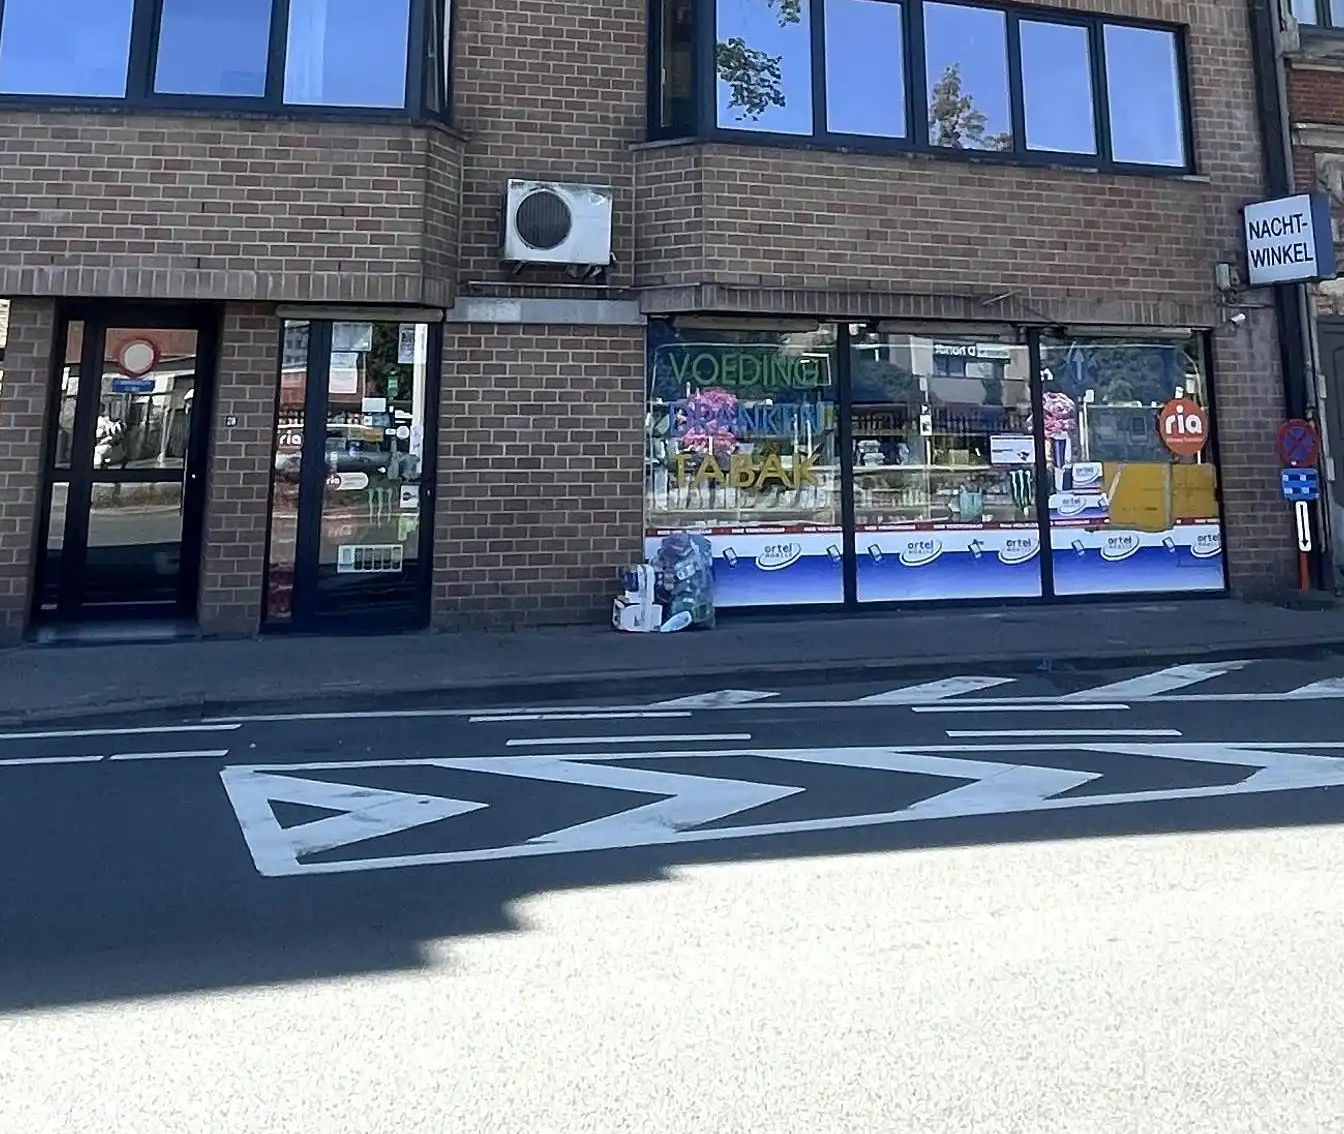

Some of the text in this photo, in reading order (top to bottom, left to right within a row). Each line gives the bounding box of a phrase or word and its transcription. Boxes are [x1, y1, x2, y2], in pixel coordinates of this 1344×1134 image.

[1248, 212, 1308, 240] NACHT-
[1249, 242, 1314, 268] WINKEL
[668, 352, 819, 387] VOEDING
[1165, 404, 1203, 435] ria
[279, 429, 302, 445] ria
[672, 453, 821, 489] TABAK
[764, 543, 793, 554] ortel
[907, 539, 934, 550] ortel
[1006, 537, 1032, 548] ortel
[1107, 534, 1132, 545] ortel
